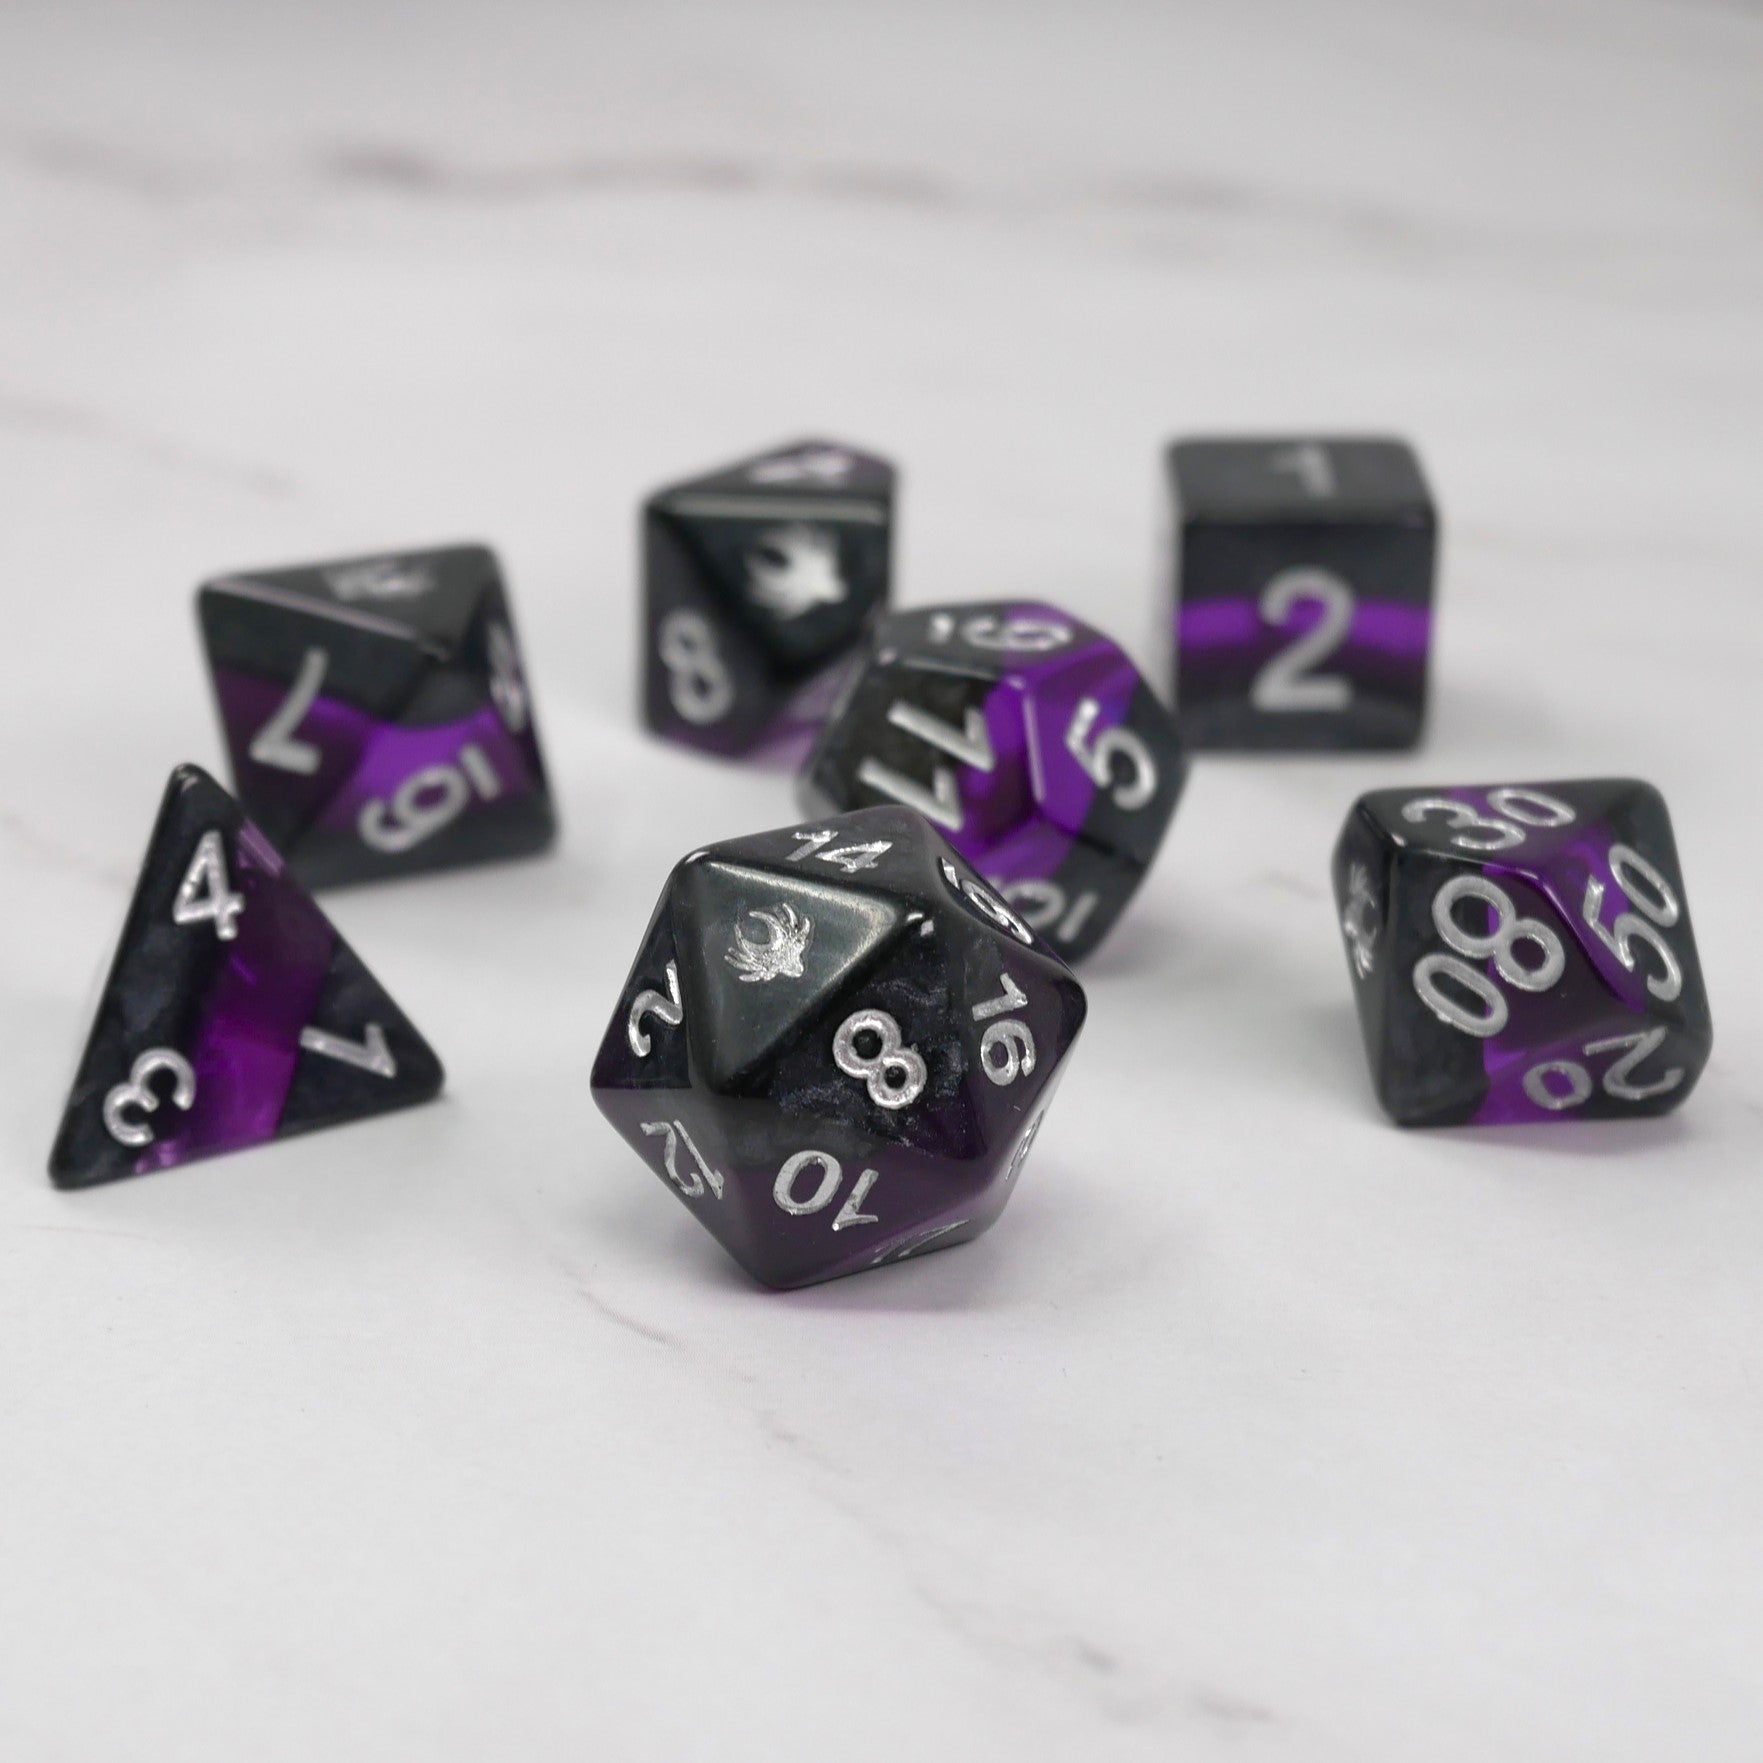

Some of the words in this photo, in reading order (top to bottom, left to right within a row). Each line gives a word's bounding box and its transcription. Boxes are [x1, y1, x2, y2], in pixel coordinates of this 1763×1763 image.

[658, 607, 733, 723] 8
[1251, 567, 1353, 712] 2
[1066, 698, 1158, 809] 5
[786, 829, 894, 873] 14
[1402, 788, 1577, 850] 30
[172, 830, 245, 940] 4
[1582, 844, 1688, 1002] 50
[1412, 874, 1566, 1038] 80
[300, 1023, 397, 1079] 1
[627, 960, 684, 1058] 2
[832, 1008, 928, 1110] 8
[971, 973, 1036, 1087] 16
[103, 1048, 196, 1148] 3
[1522, 1025, 1684, 1111] 20
[640, 1119, 724, 1200] 12
[772, 1150, 879, 1232] 10
